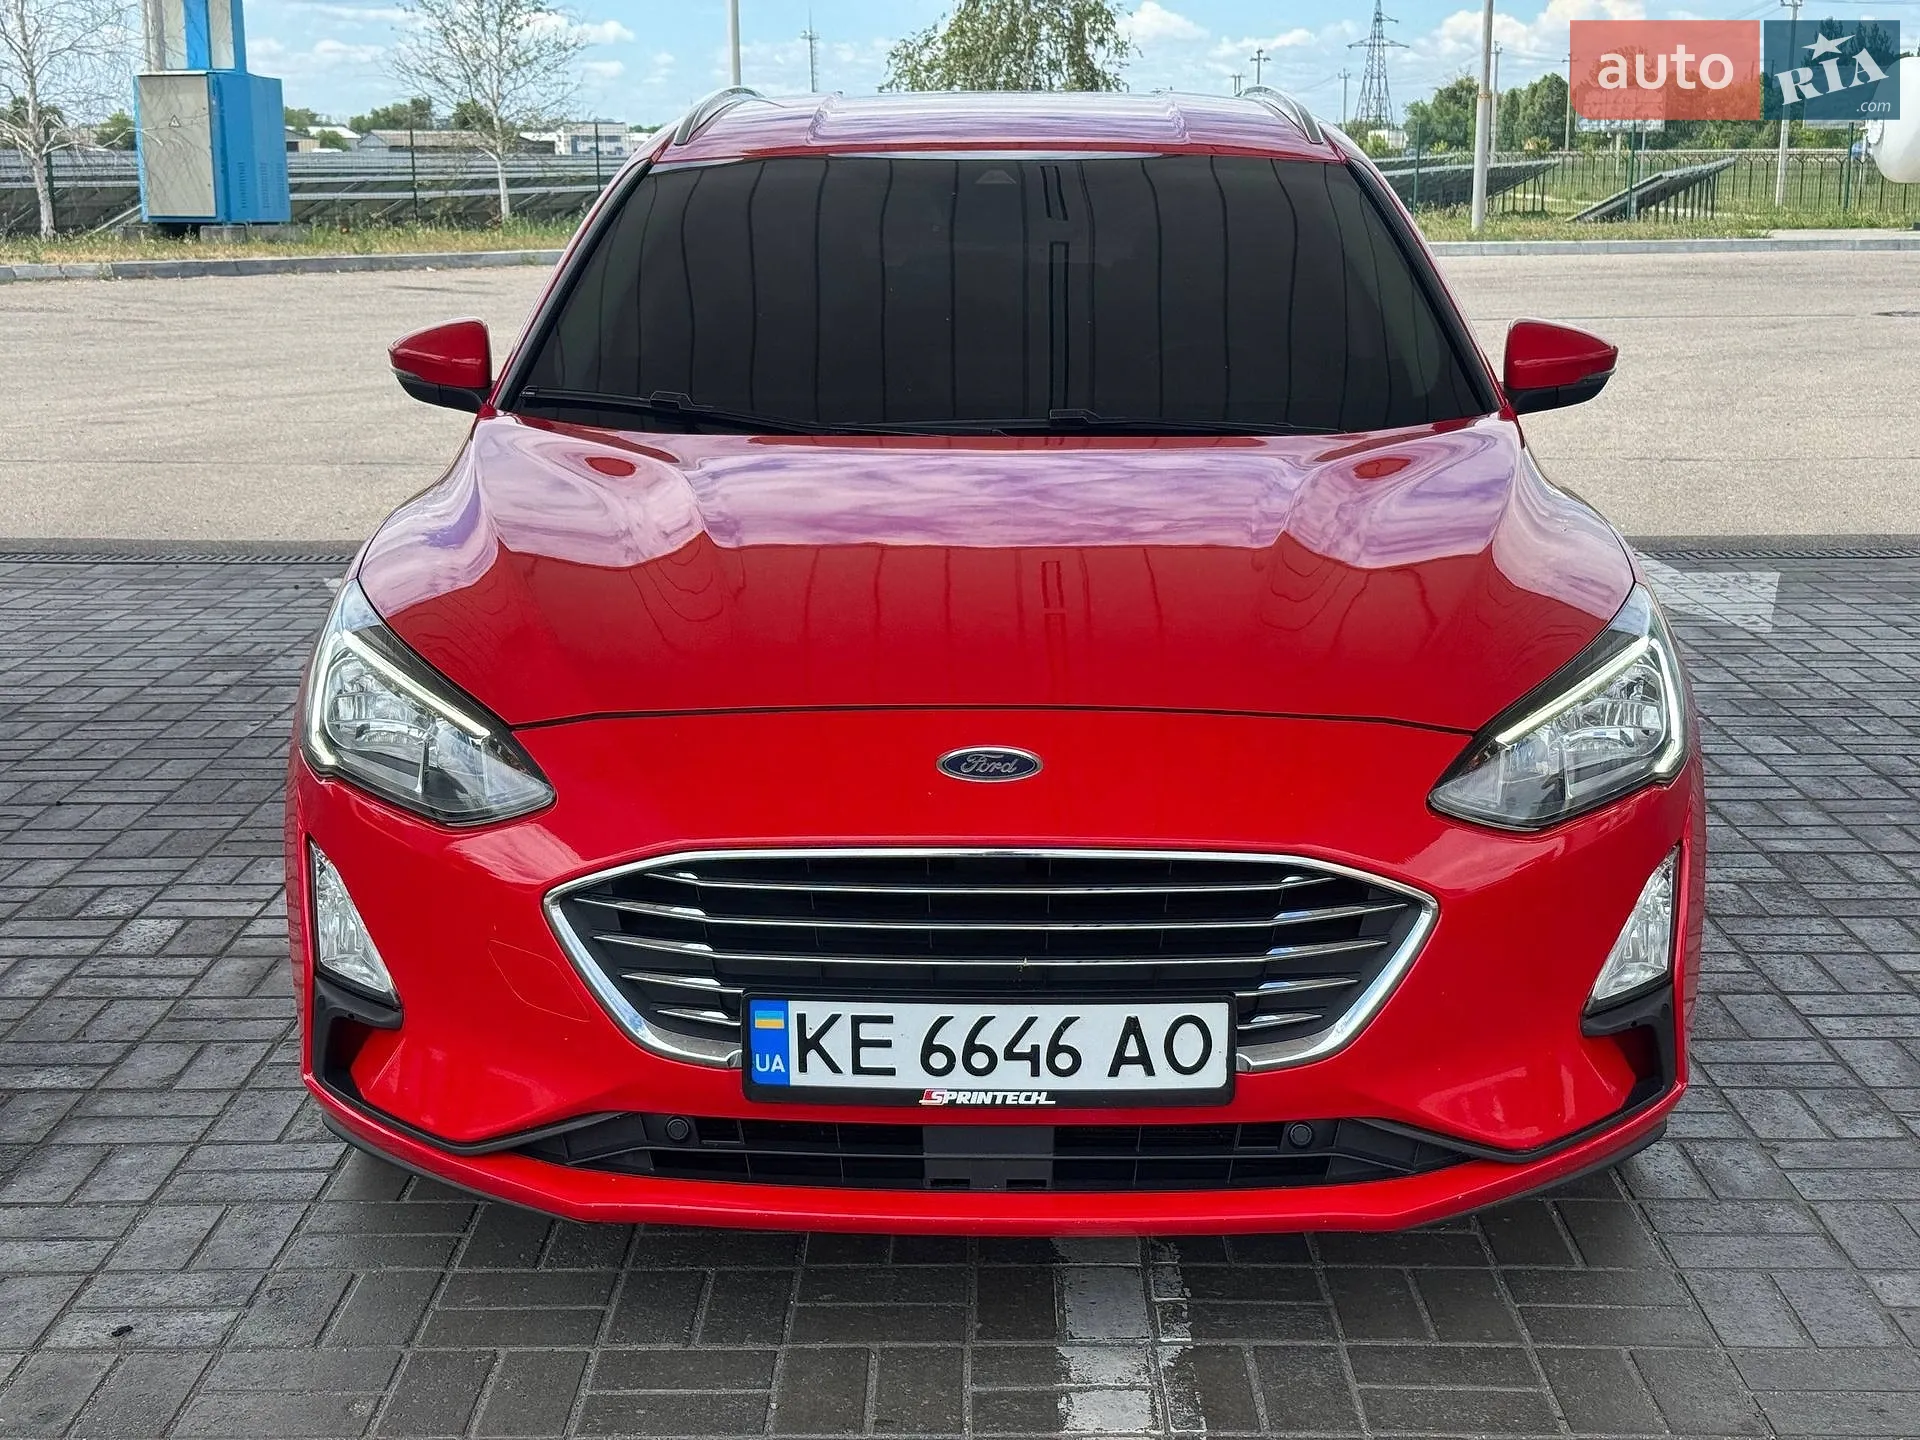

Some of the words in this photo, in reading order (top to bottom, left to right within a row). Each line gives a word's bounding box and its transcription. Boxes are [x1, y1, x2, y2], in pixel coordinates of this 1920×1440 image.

[960, 753, 1017, 773] Ford
[796, 1013, 896, 1076] KE
[920, 1016, 1083, 1077] 6646
[1107, 1014, 1213, 1077] AO
[755, 1055, 785, 1073] UA
[919, 1089, 1056, 1106] SPRINTECH
